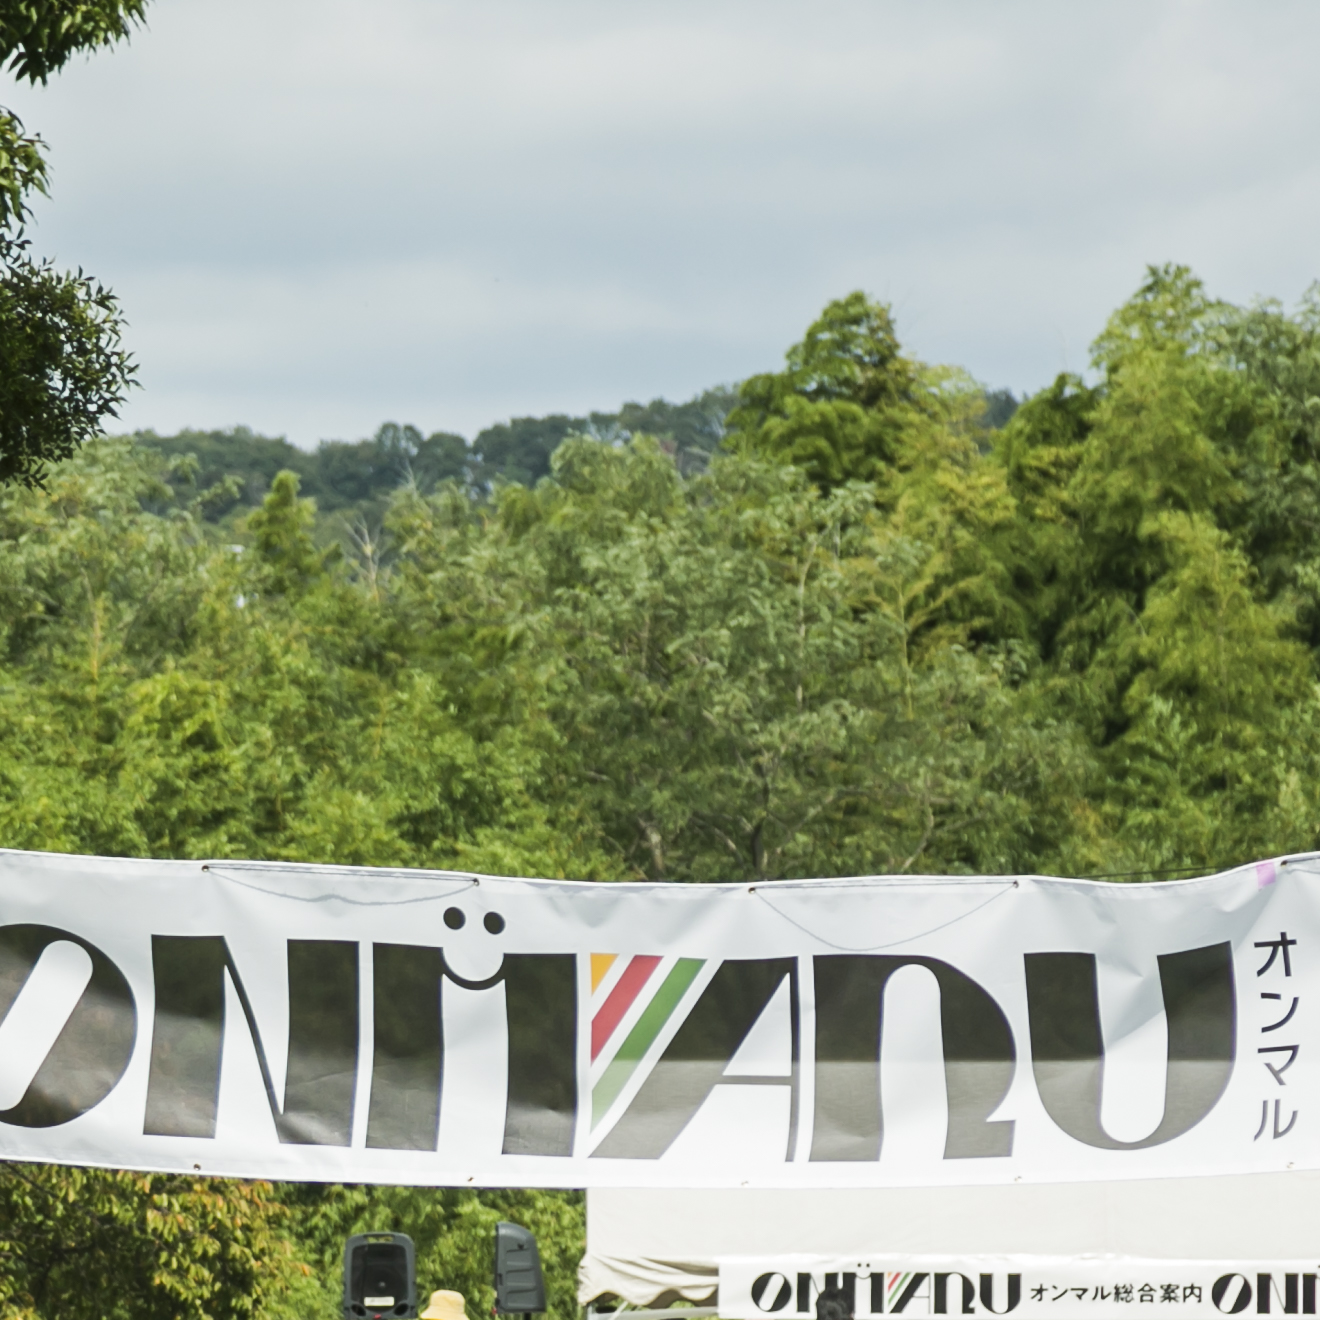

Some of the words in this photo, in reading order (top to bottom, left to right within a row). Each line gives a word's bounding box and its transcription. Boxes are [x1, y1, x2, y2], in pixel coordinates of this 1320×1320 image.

[1253, 931, 1300, 1142] オンマル
[1029, 1282, 1203, 1304] オンマル総合案内
